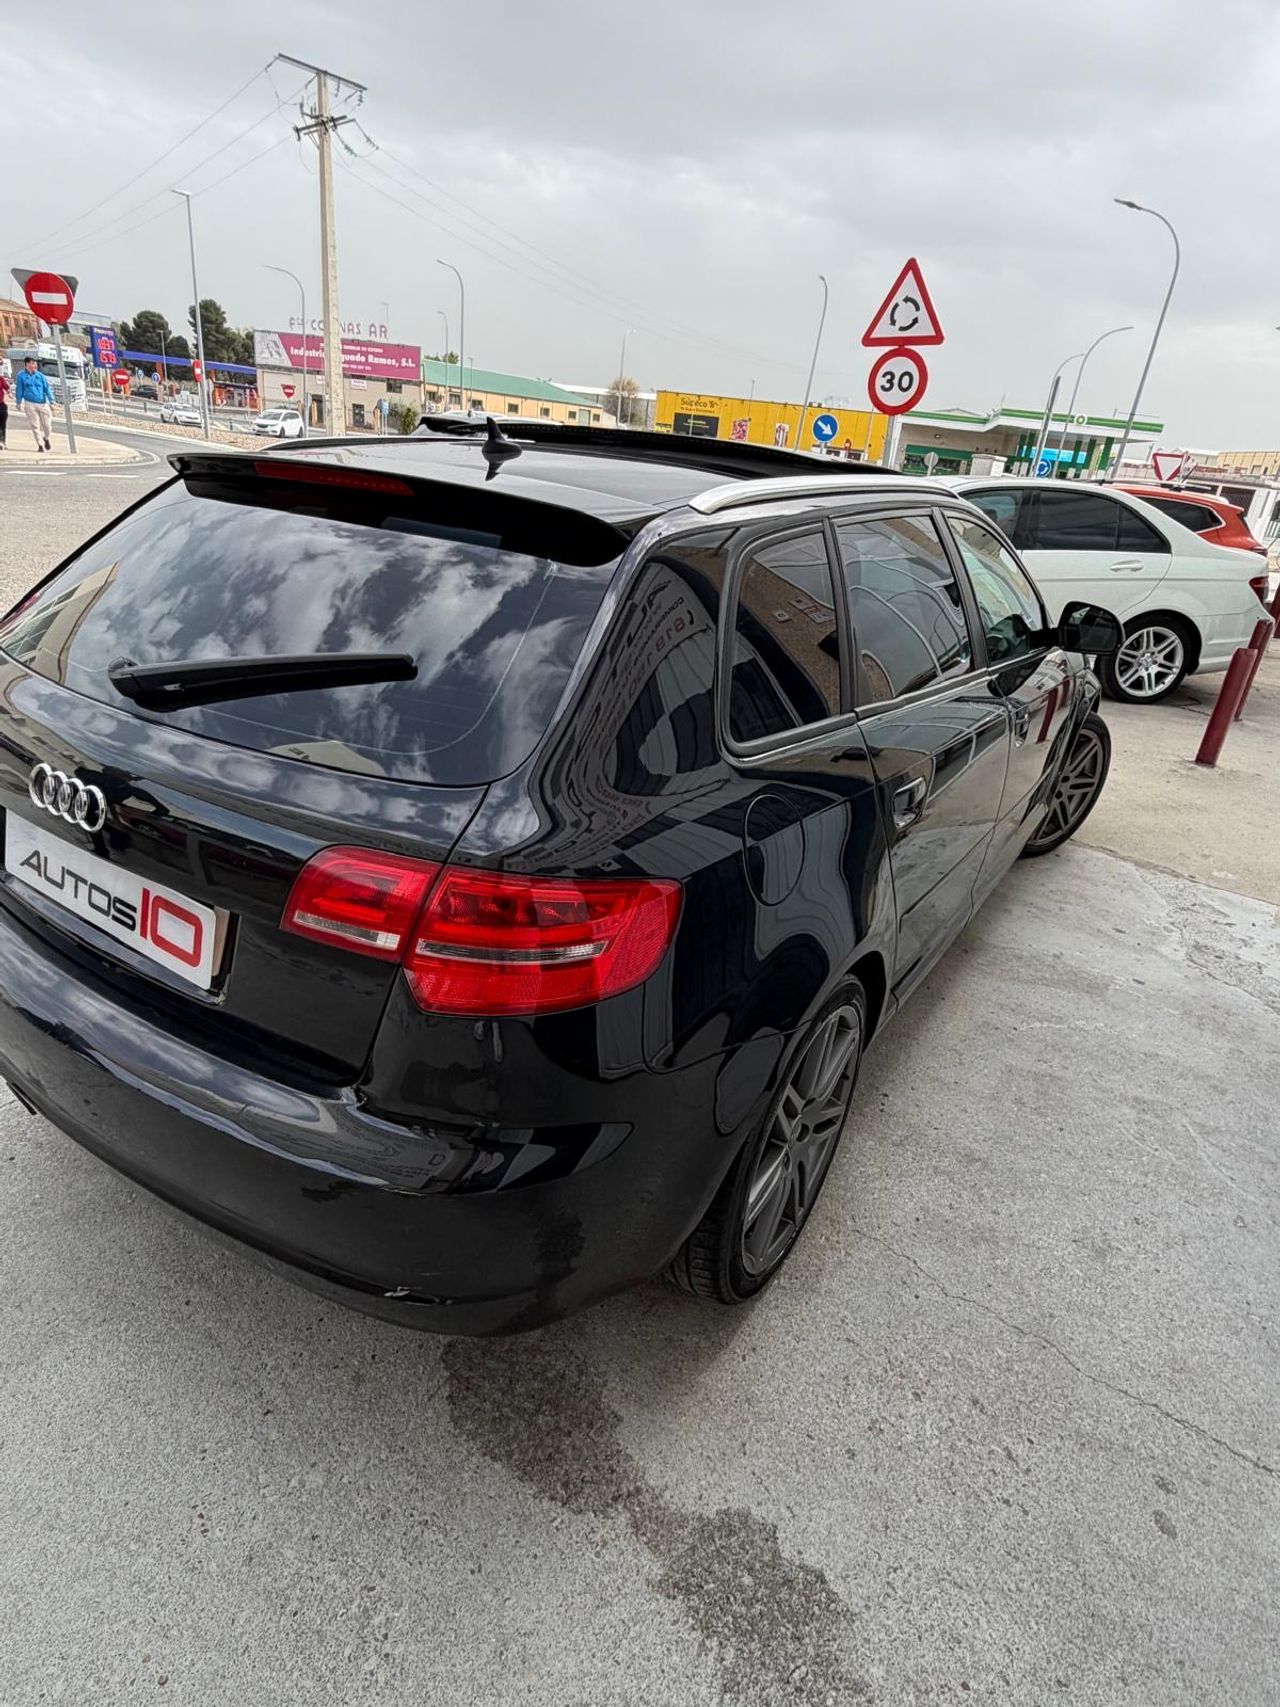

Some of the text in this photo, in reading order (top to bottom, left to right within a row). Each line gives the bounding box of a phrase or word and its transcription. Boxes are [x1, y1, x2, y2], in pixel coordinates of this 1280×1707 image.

[368, 354, 399, 368] Ramos,
[401, 357, 416, 369] S.L.
[880, 370, 914, 393] 30
